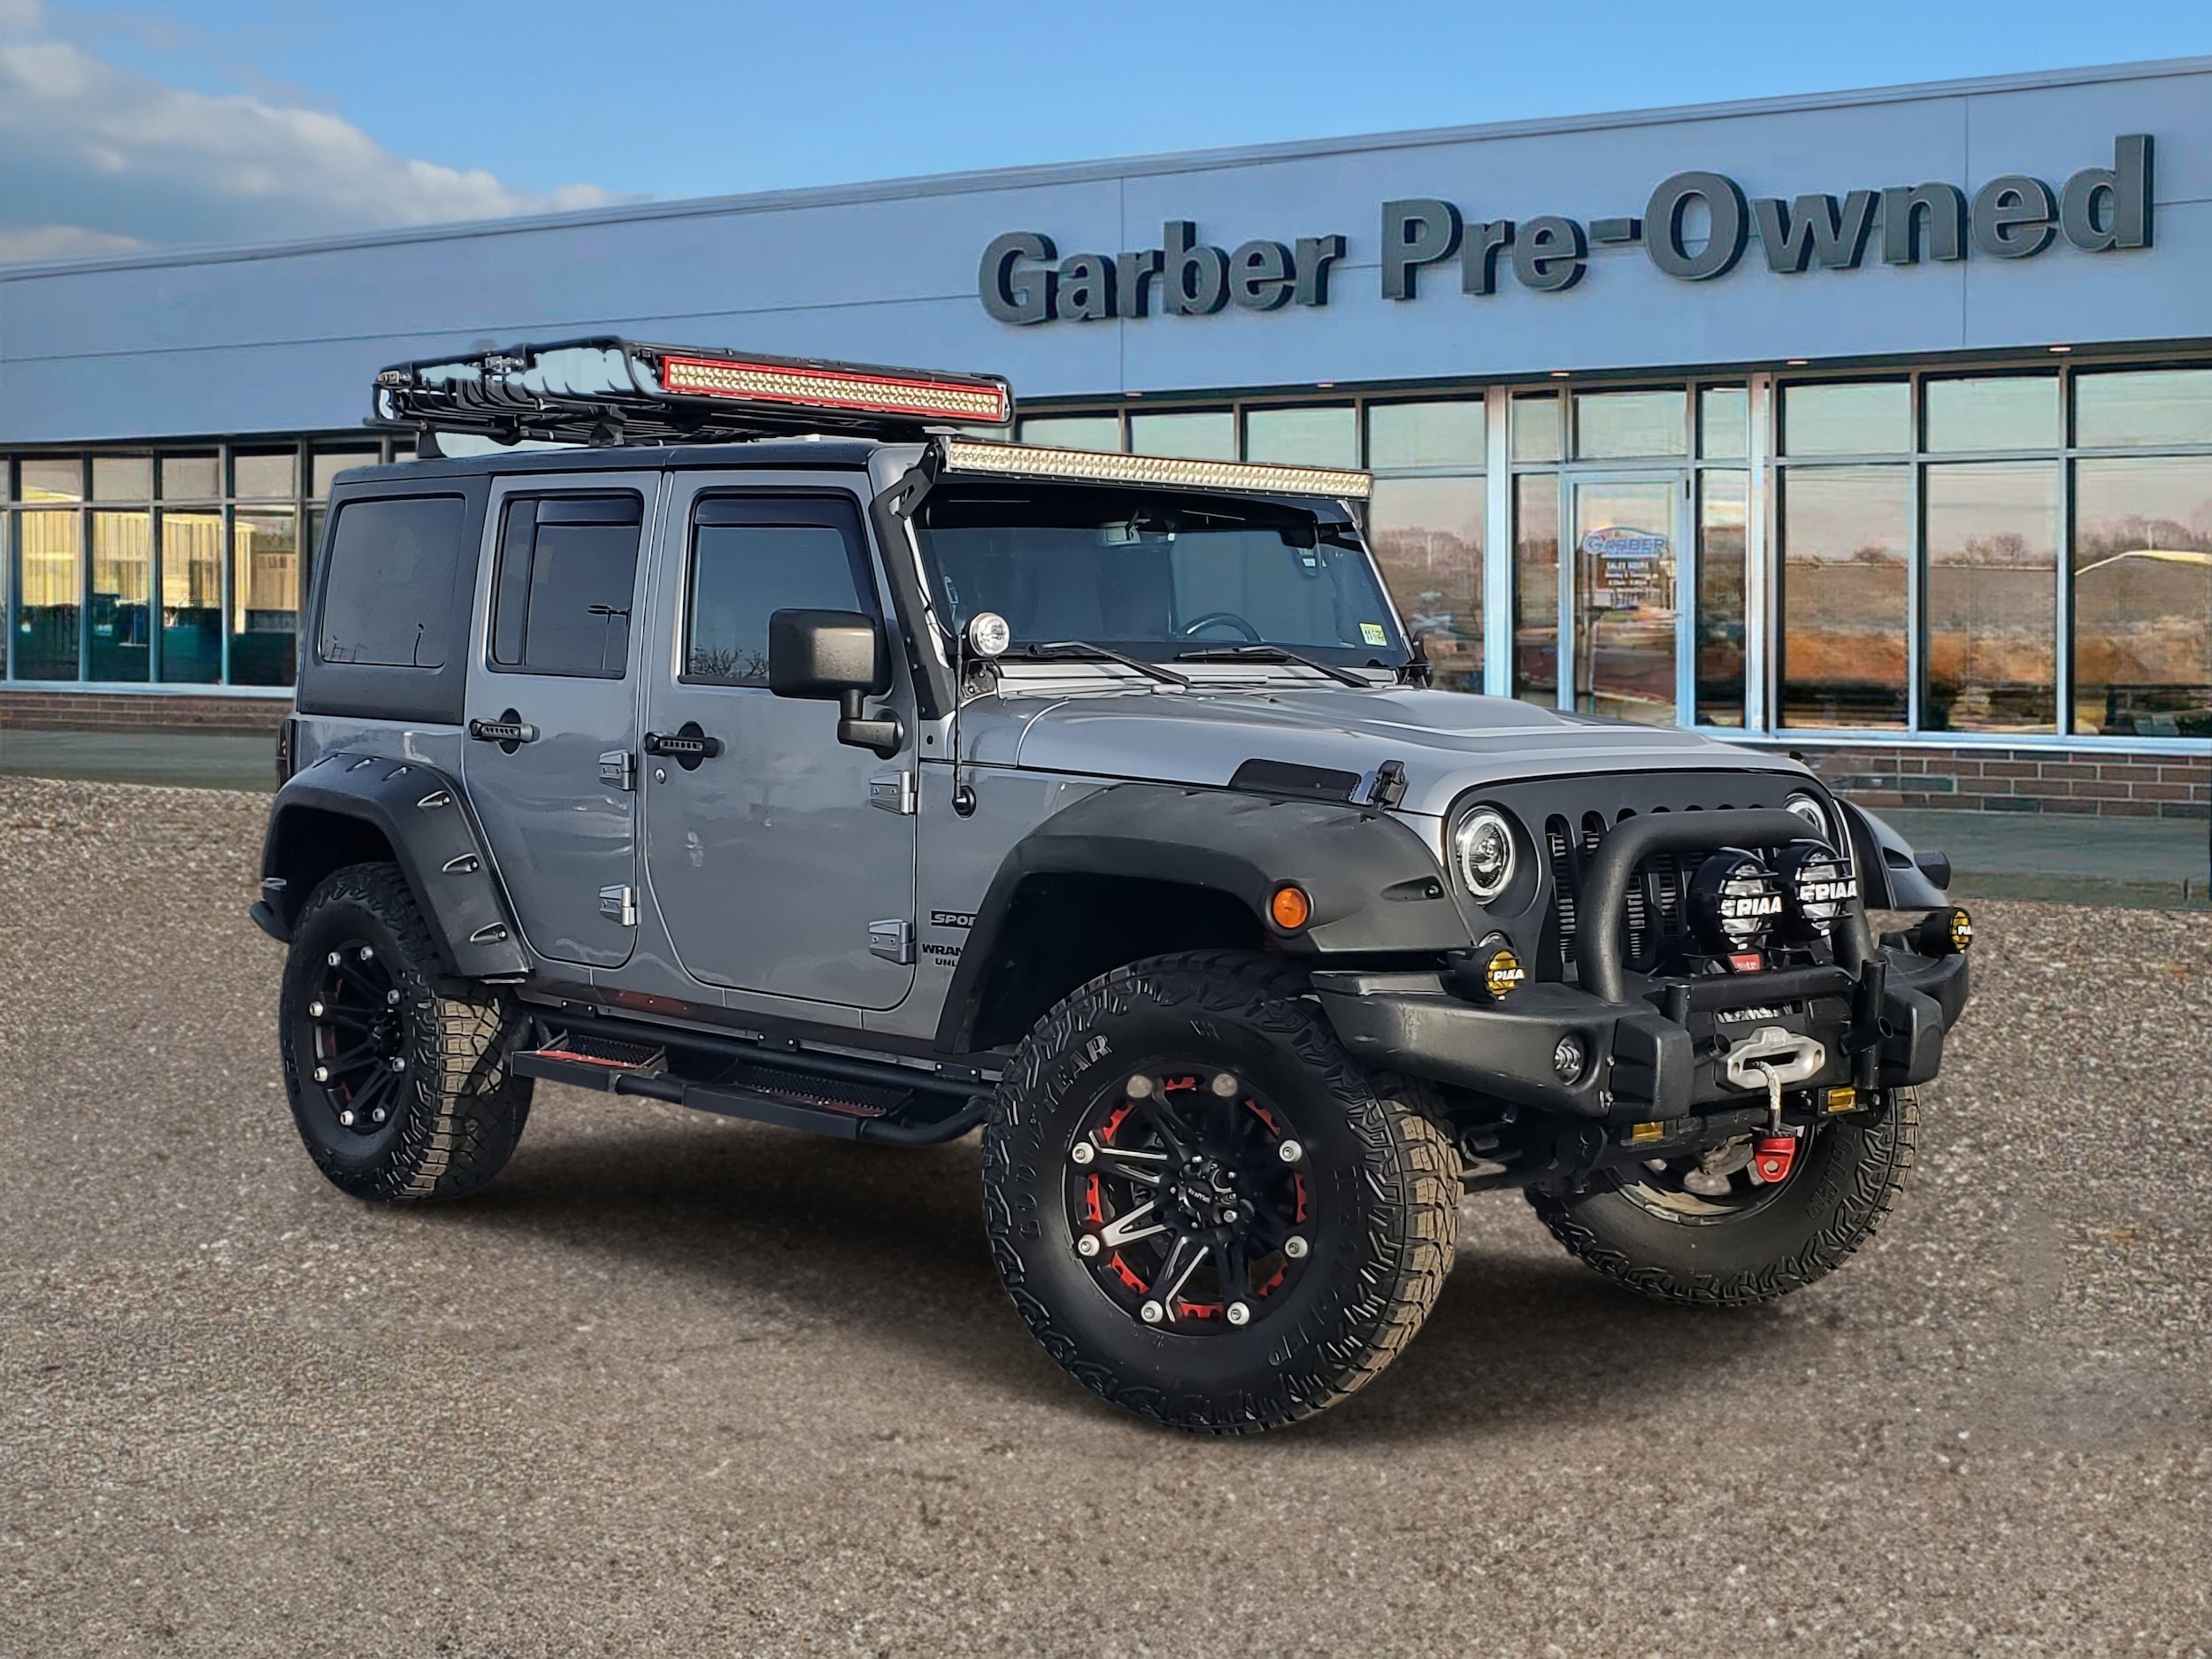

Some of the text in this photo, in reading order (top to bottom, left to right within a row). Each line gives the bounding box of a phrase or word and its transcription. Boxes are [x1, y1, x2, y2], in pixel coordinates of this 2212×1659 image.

[979, 134, 2154, 325] Garber Pre-Owned
[1586, 535, 1665, 554] GARBER
[1493, 969, 1525, 981] PIAA
